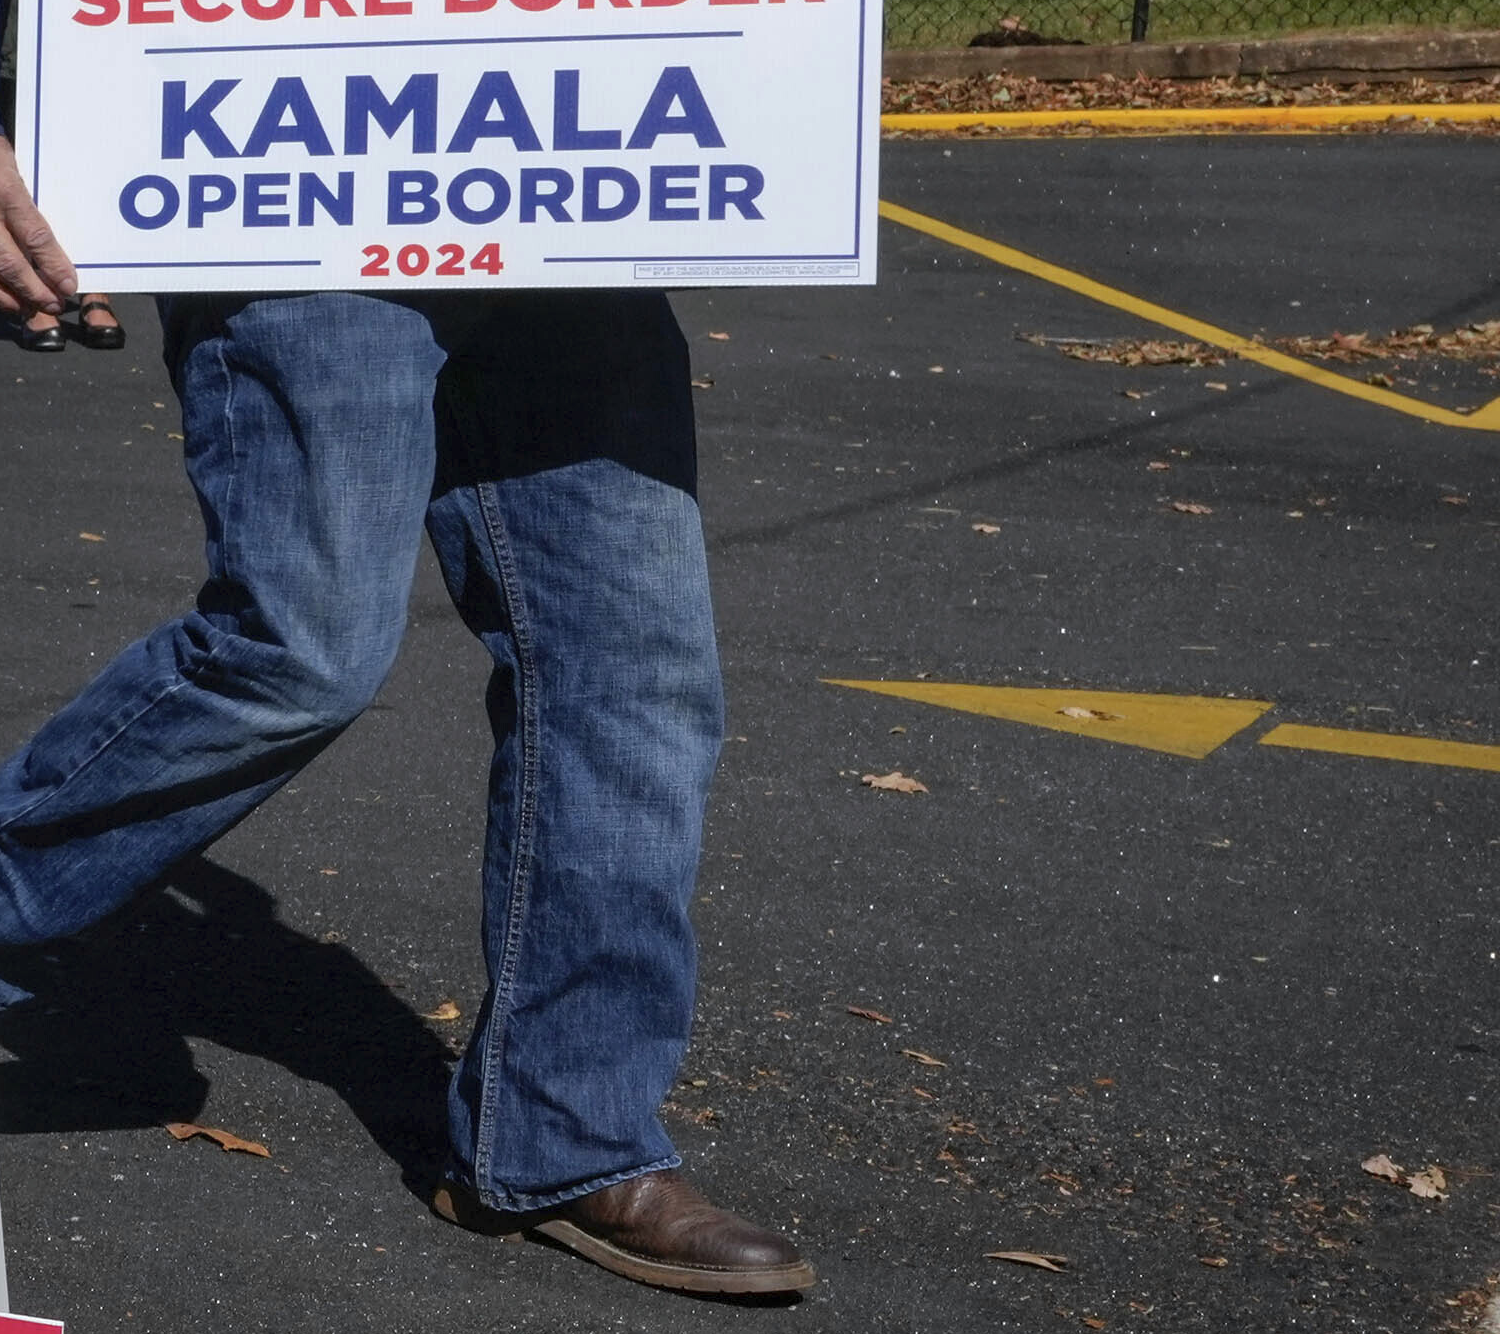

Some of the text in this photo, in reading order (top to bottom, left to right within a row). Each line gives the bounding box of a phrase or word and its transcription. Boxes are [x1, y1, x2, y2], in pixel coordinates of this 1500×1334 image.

[161, 66, 726, 159] KAMALA
[118, 164, 766, 230] OPEN BORDER
[361, 243, 504, 277] 2024
